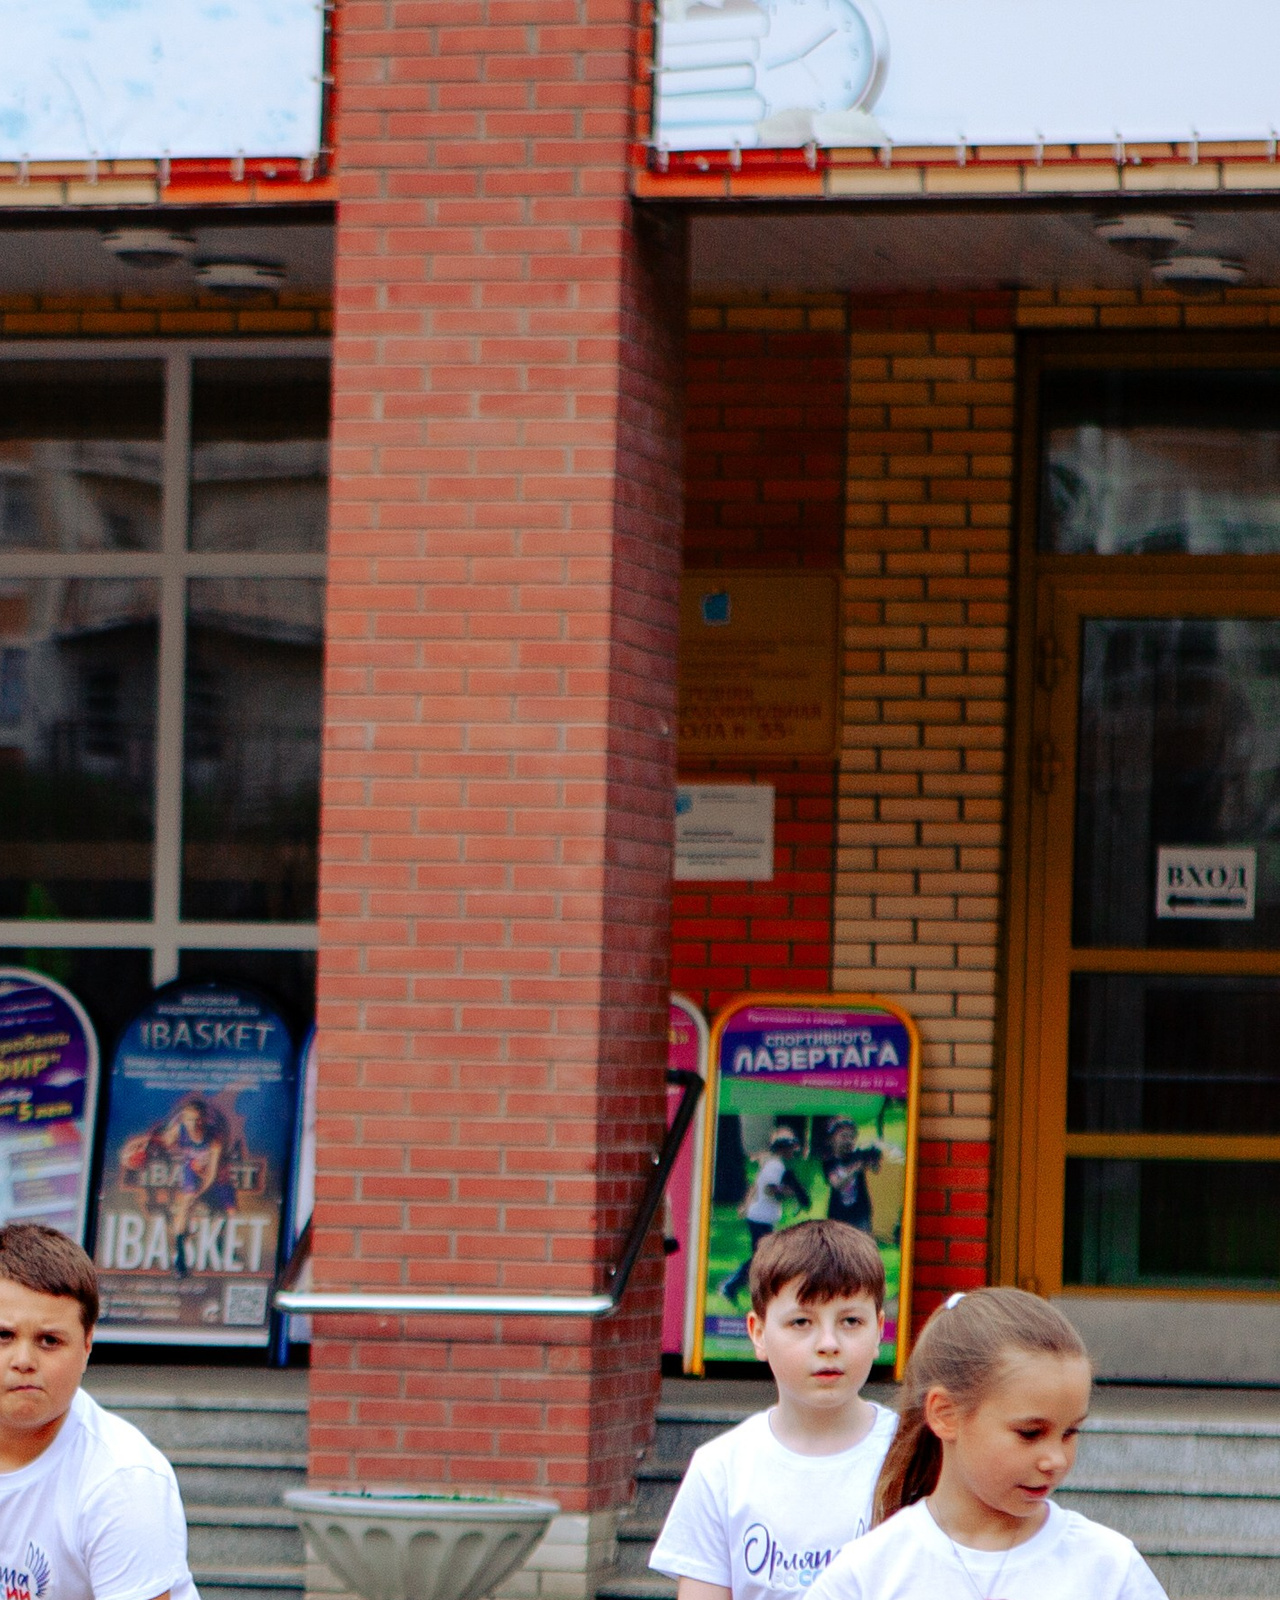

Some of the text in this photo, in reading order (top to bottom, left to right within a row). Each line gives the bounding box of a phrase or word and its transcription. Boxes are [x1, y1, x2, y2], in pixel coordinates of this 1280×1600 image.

[1167, 865, 1246, 889] ВХОД
[140, 1021, 275, 1050] IBASKET
[734, 1041, 900, 1073] ЛАЗЕРТАГА
[743, 1523, 842, 1581] Орлят
